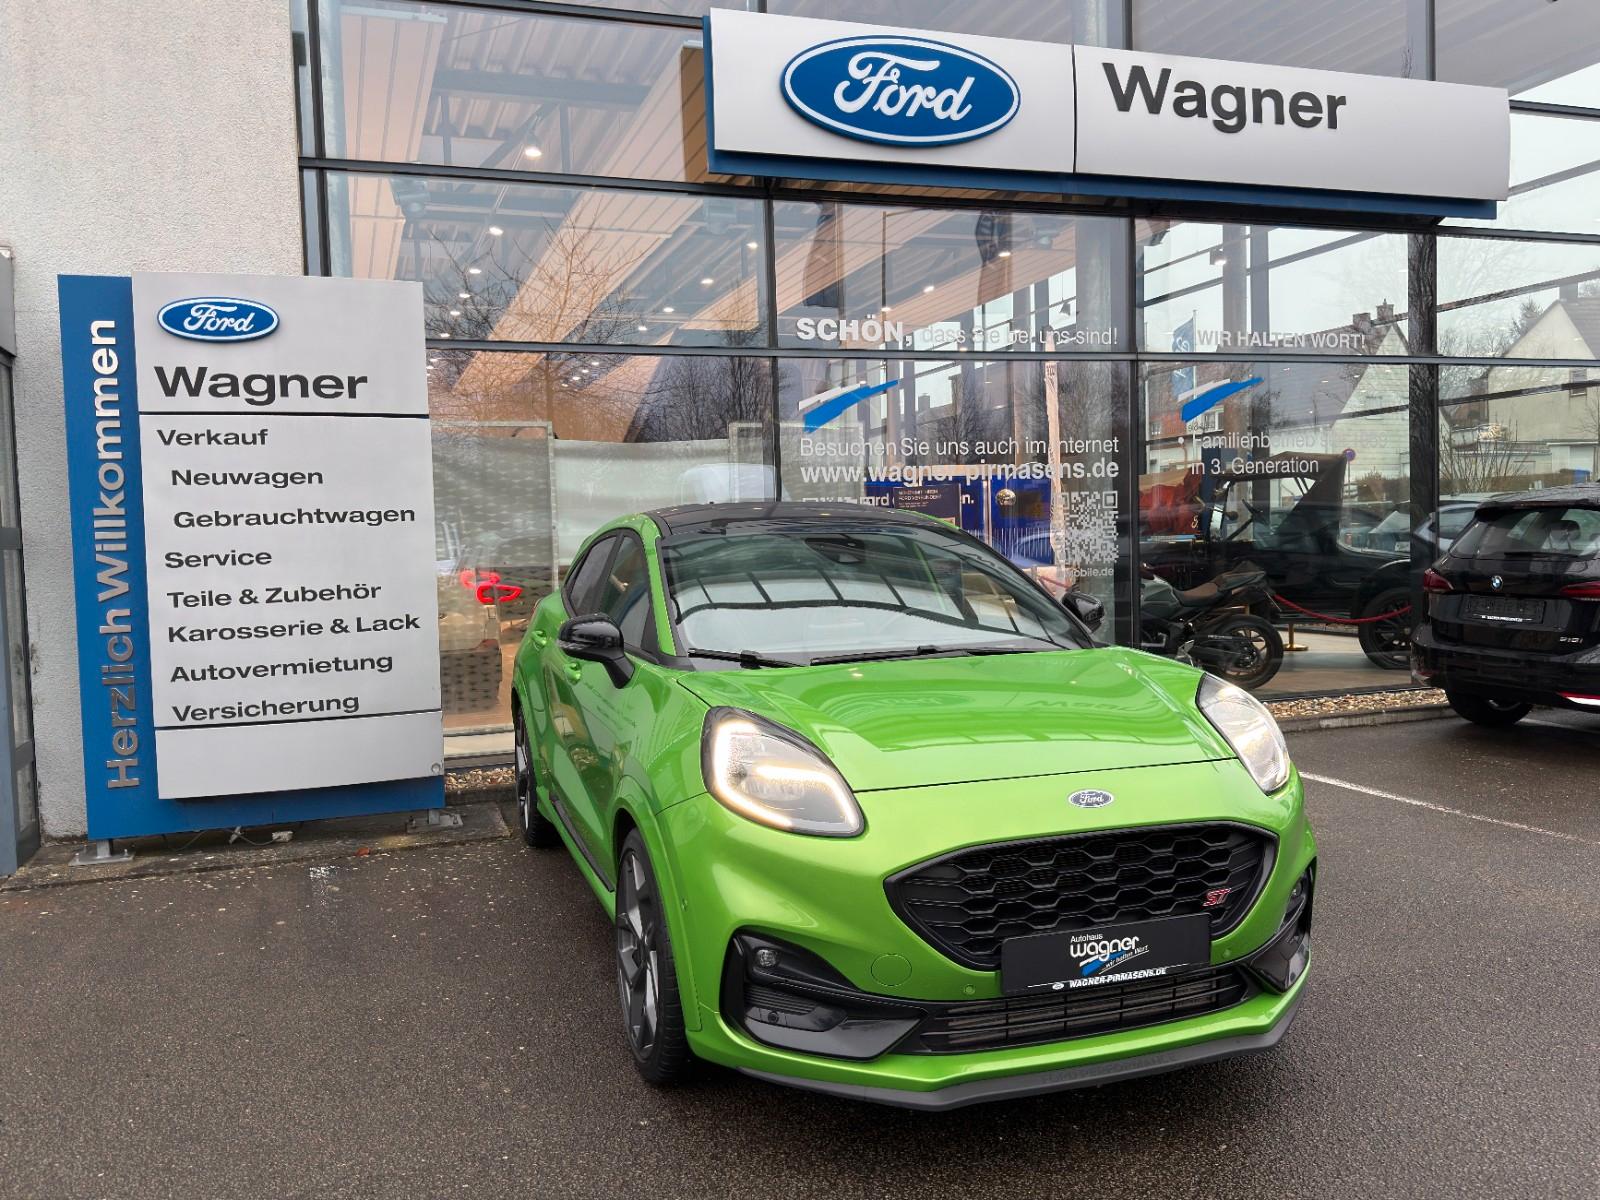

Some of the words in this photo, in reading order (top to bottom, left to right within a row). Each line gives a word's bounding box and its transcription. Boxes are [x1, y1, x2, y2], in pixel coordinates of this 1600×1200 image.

[834, 51, 976, 122] Ford
[1102, 62, 1347, 133] Wagner
[183, 303, 255, 333] Ford
[796, 314, 913, 347] SCHÖN,
[972, 326, 1000, 344] Se
[1074, 327, 1118, 345] sind!
[1197, 329, 1232, 347] WIR
[1237, 331, 1305, 348] HALTEN
[1311, 332, 1366, 349] WORT!
[154, 366, 368, 406] Wagner
[156, 429, 269, 447] Verkauf
[800, 437, 897, 457] Besuchen
[901, 437, 930, 456] Sie
[936, 440, 970, 455] uns
[975, 436, 1019, 455] auch
[1026, 436, 1047, 454] im
[1056, 436, 1120, 455] nternet
[90, 319, 130, 602] Willkommen
[1210, 458, 1226, 475] 3.
[1231, 456, 1319, 475] Generation
[171, 468, 324, 489] Neuwagen
[173, 508, 416, 529] Gebrauchtwagen
[164, 549, 273, 569] Service
[167, 591, 232, 609] Teile
[239, 588, 258, 606] &
[265, 582, 382, 605] Zubehör
[168, 619, 324, 643] Karosserie
[330, 617, 351, 635] &
[356, 613, 421, 634] Lack
[170, 653, 394, 683] Autovermietung
[99, 608, 139, 789] Herzlich
[173, 695, 360, 722] Versicherung
[1202, 887, 1231, 907] ST
[1069, 936, 1140, 962] wagner
[1070, 933, 1104, 944] Autohaus
[1069, 967, 1167, 989] WAGNER-PIRMASENS.DE
